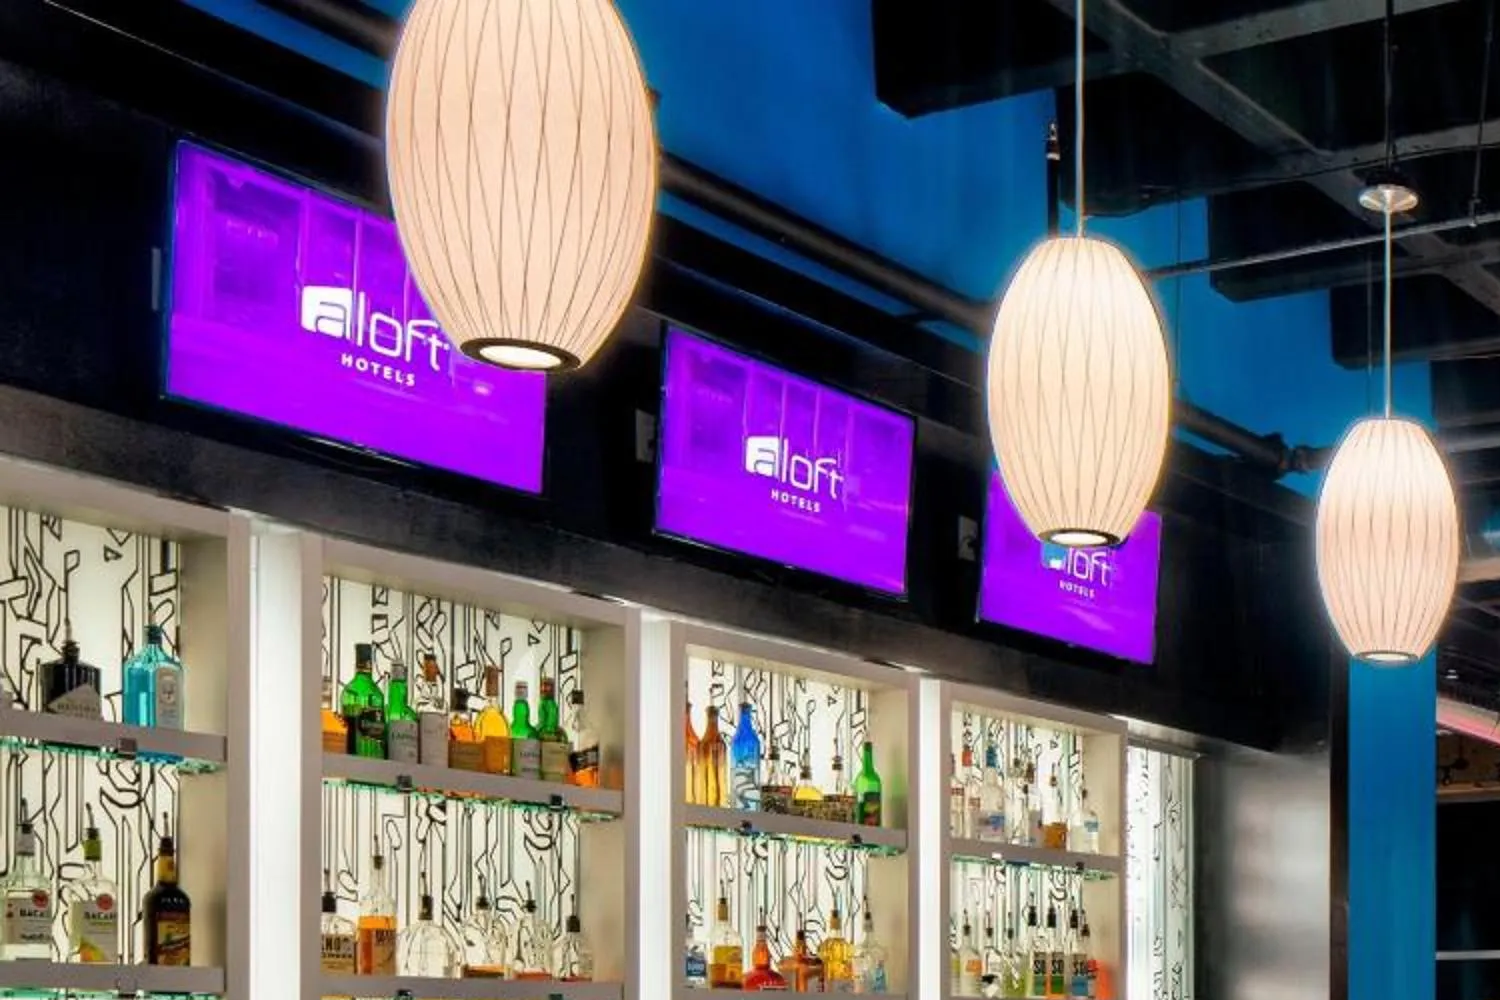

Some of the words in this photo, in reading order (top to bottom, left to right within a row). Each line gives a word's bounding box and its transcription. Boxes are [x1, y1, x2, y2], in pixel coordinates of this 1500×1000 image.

[301, 285, 448, 371] aloft
[340, 353, 415, 387] HOTELS
[745, 436, 844, 499] aloft
[771, 489, 820, 513] HOTELS
